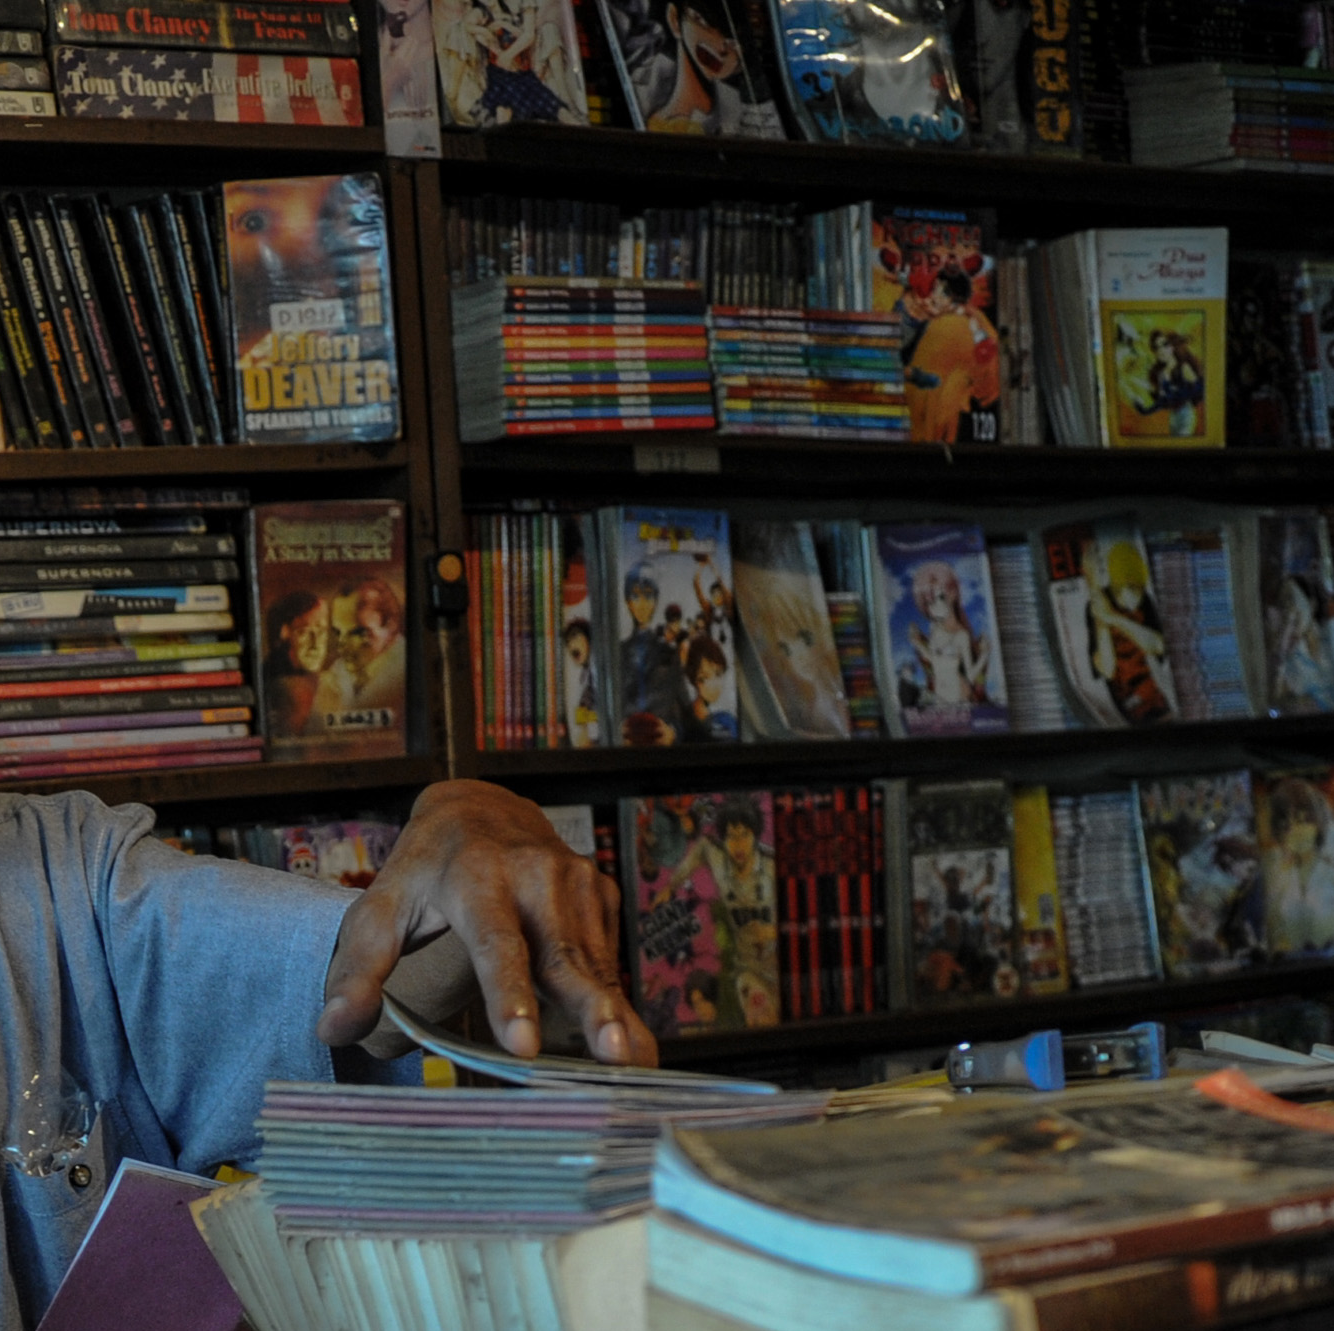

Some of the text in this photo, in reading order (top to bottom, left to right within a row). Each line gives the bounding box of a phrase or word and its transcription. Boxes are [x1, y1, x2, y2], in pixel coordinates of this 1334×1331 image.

[124, 7, 212, 43] Clancy
[68, 71, 198, 104] Tom Clancy
[269, 331, 360, 364] Jeffery
[243, 359, 392, 412] DEAVER
[245, 410, 313, 431] SPEAKING
[43, 544, 124, 557] SUPERNOVA
[36, 567, 135, 581] SUPERNOVA
